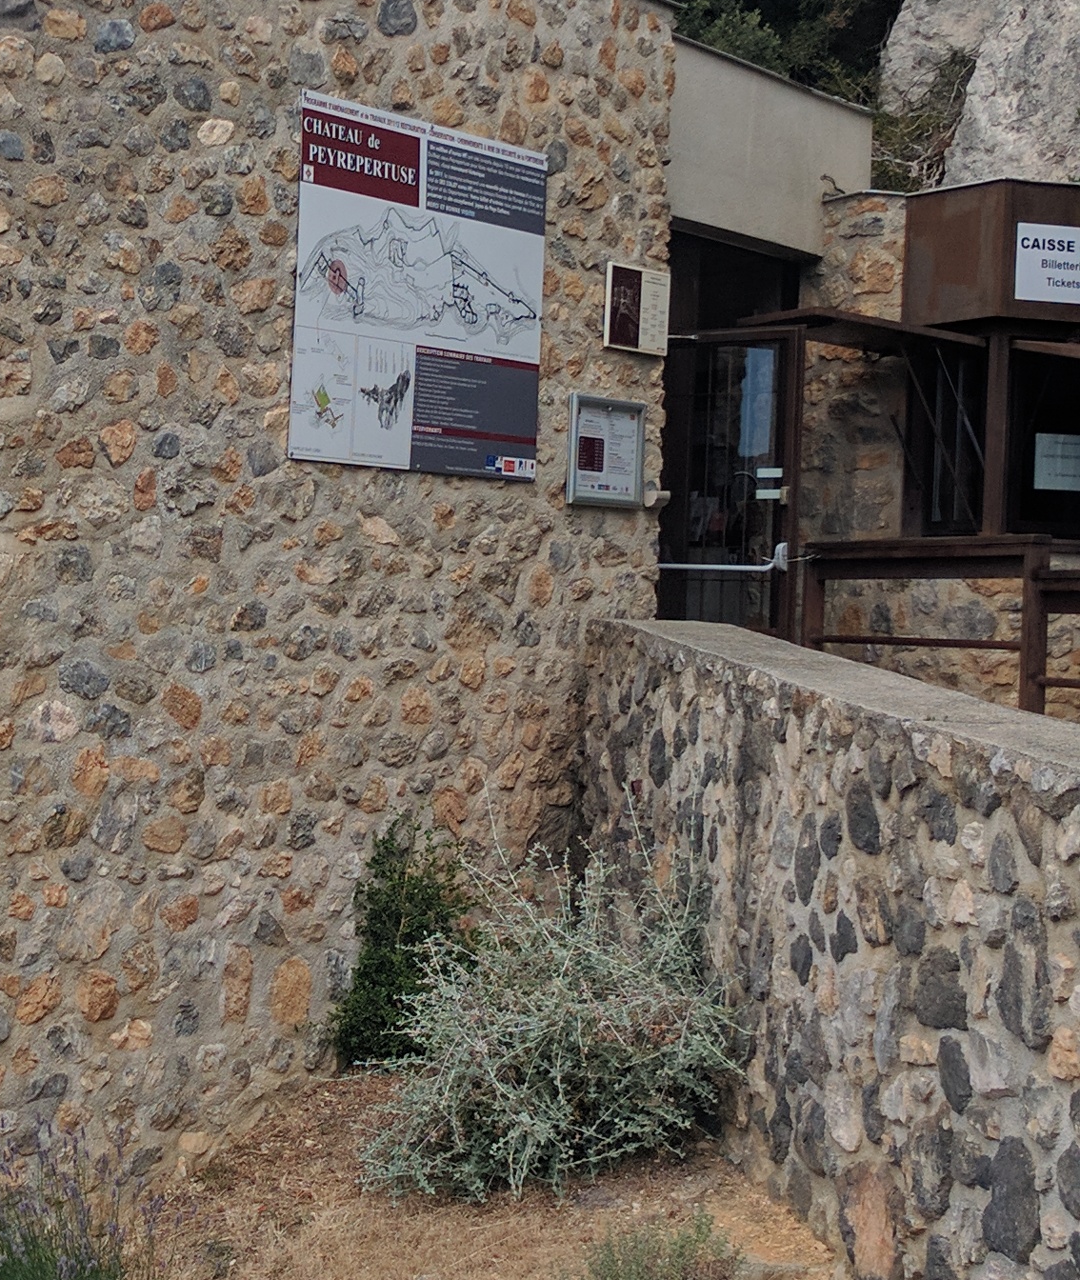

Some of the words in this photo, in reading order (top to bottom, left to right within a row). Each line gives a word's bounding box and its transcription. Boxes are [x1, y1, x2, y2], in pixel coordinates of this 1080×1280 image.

[303, 116, 363, 146] CHATEAU
[367, 133, 381, 151] de
[308, 143, 417, 186] PEYREPERTUSE
[1020, 237, 1076, 253] CAISSE
[1046, 277, 1080, 290] Tickets
